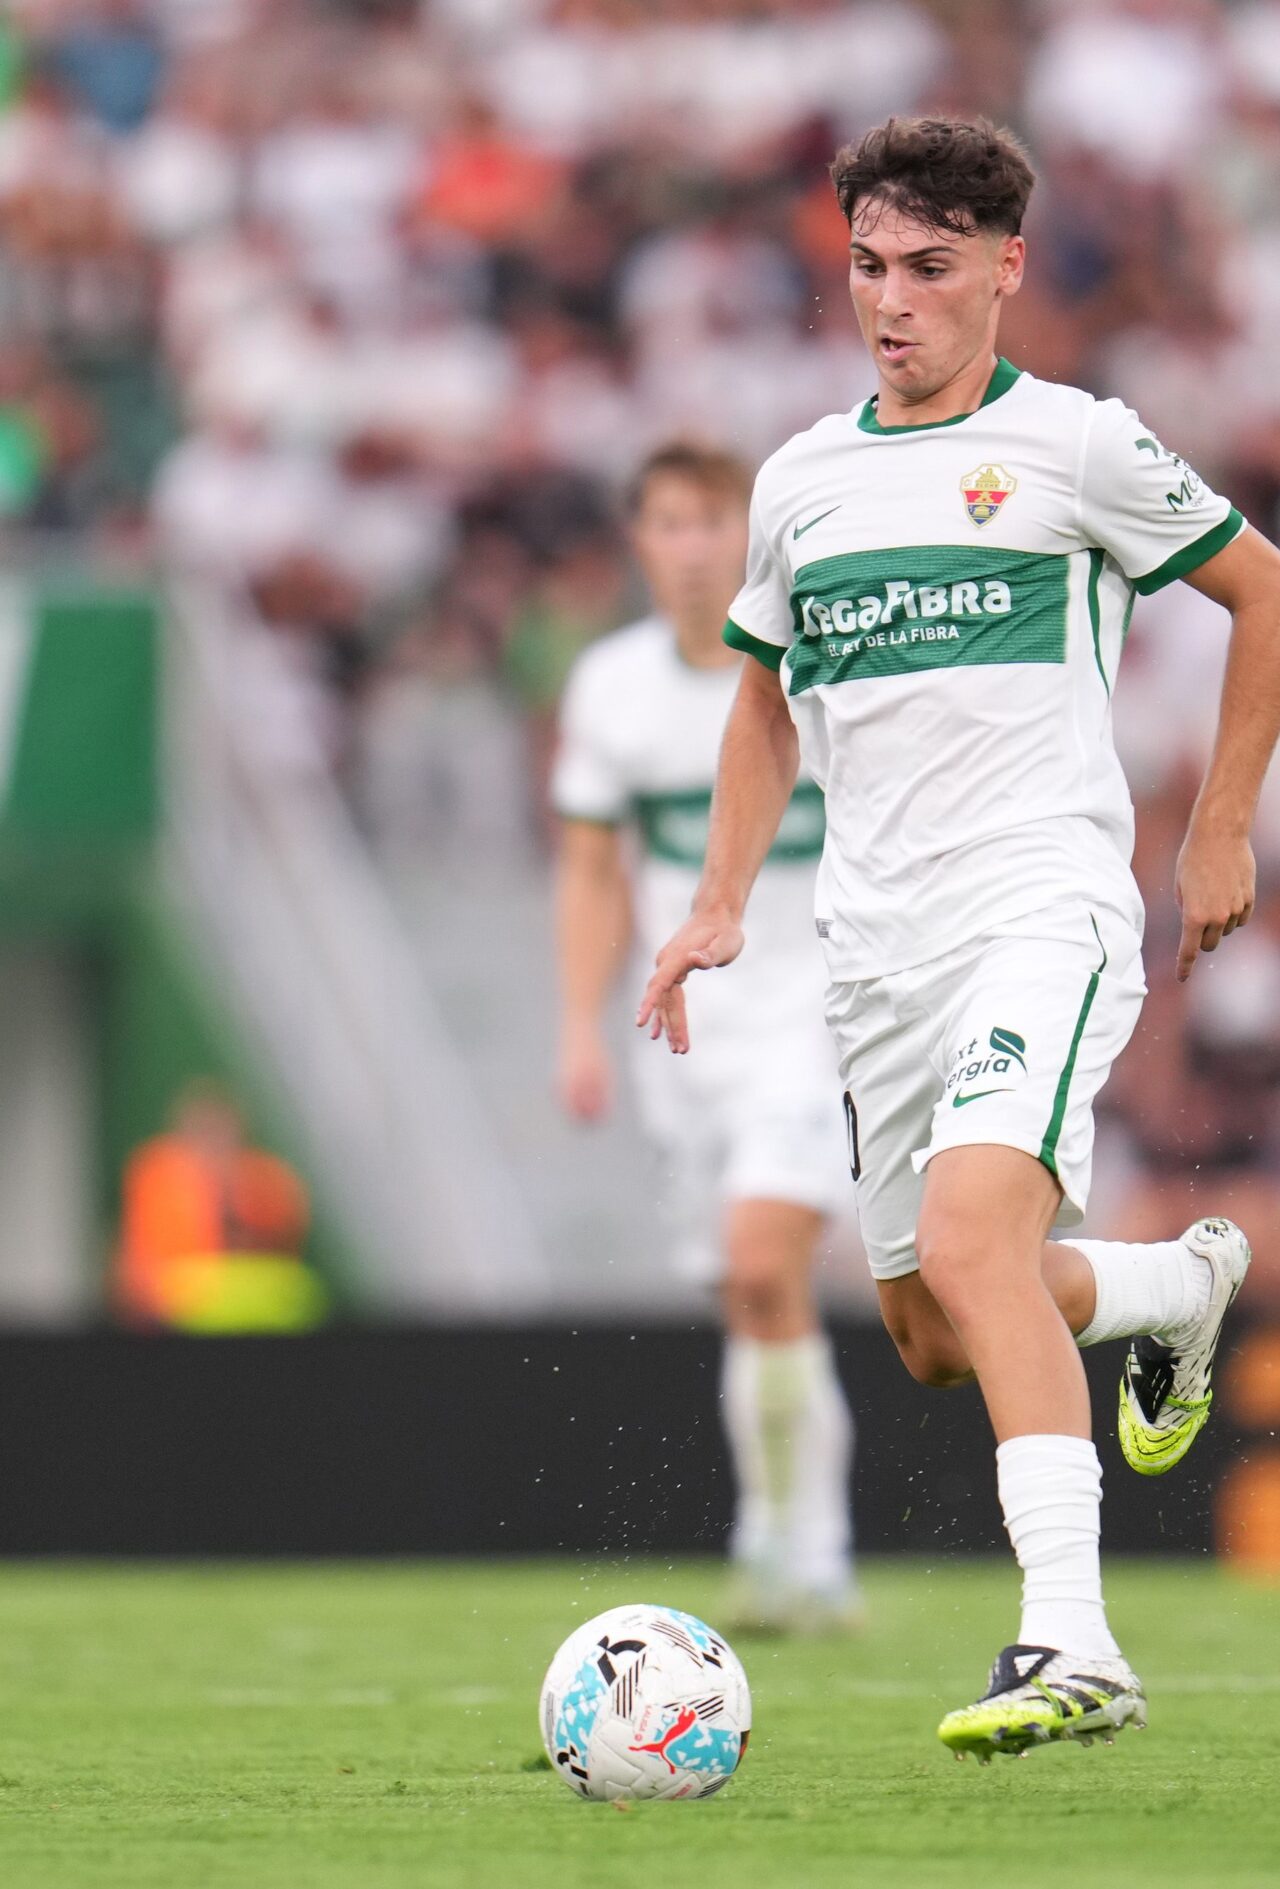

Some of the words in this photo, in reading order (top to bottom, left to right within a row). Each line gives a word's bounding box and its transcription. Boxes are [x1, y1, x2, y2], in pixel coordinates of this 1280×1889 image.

[864, 632, 887, 648] DE
[889, 630, 908, 645] LA
[910, 624, 960, 643] FIBRA
[947, 1052, 1011, 1089] ergía
